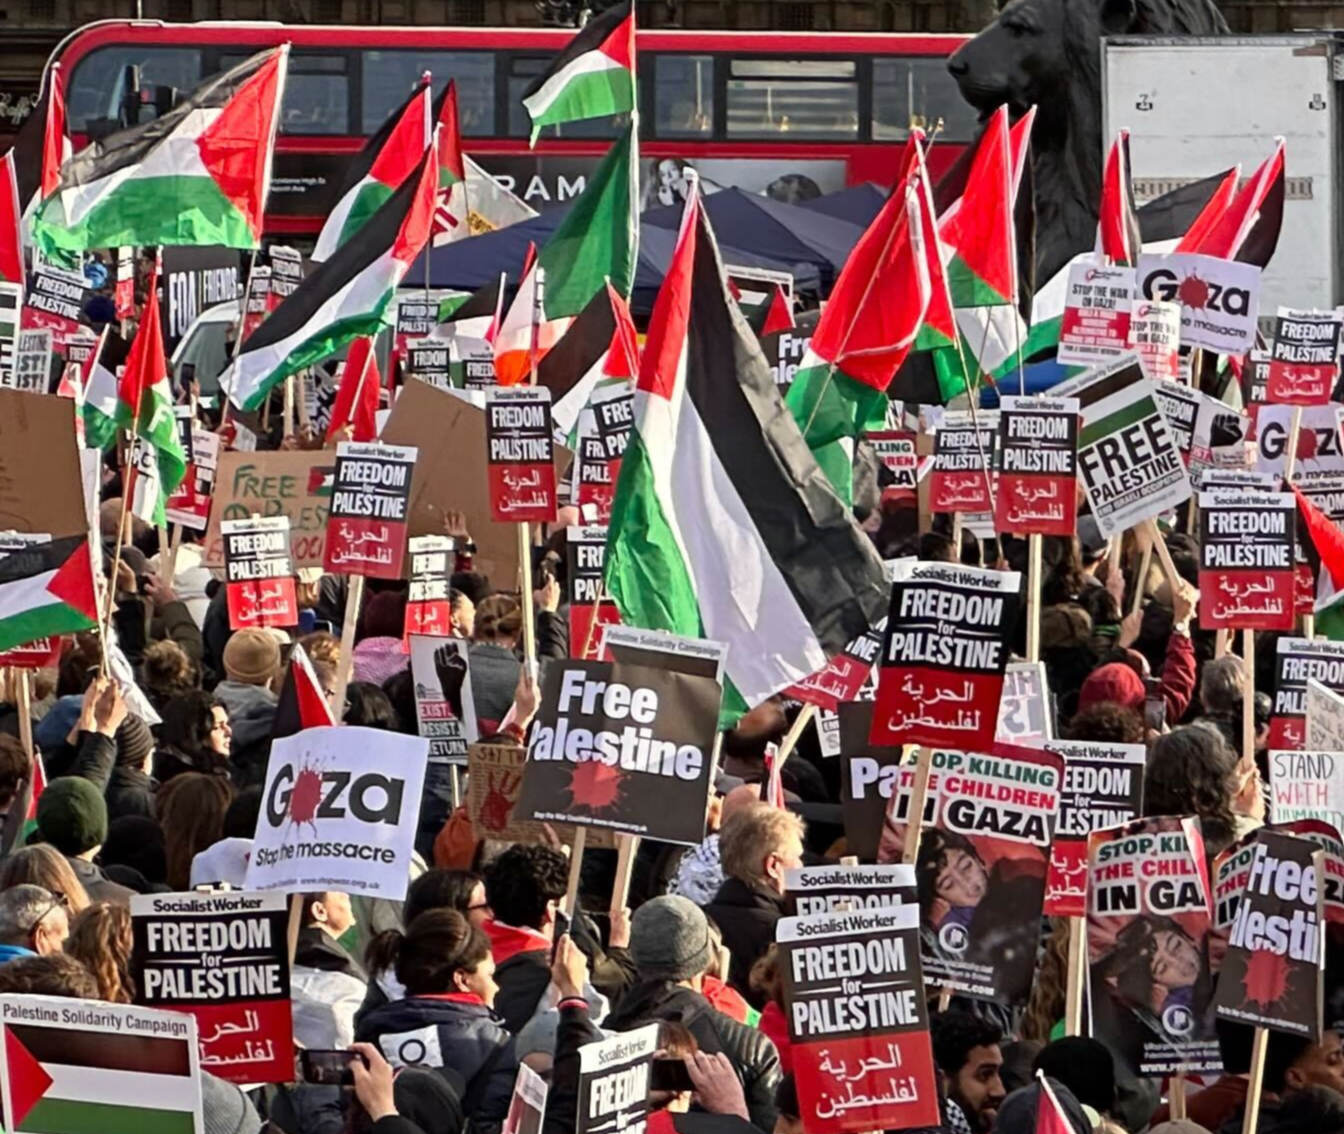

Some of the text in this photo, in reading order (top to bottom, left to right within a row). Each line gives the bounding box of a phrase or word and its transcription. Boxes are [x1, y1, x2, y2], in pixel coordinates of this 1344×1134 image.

[1281, 321, 1334, 341] FREEDOM
[1275, 341, 1335, 363] PALESTINE
[1008, 414, 1068, 440] FREEDOM
[1003, 449, 1072, 473] PALESTINE
[1077, 420, 1173, 488] FREE
[233, 466, 297, 500] FREE
[339, 458, 406, 487] FREEDOM
[1090, 451, 1179, 504] PALESTINE
[331, 490, 404, 519] PALESTINE
[1209, 510, 1285, 536] FREEDOM
[1204, 543, 1288, 568] PALESTINE
[899, 587, 1001, 627] FREEDOM
[888, 636, 1001, 670] PALESTINE
[558, 669, 658, 724] Free
[907, 749, 1056, 788] SOP KILLING
[1274, 753, 1335, 780] STAND
[266, 764, 407, 829] Gza
[900, 771, 1055, 811] TE CHILDREN
[1275, 781, 1329, 807] WITH
[946, 799, 1047, 842] GAZA
[1099, 838, 1154, 862] STOP
[1093, 862, 1135, 882] THE
[1248, 843, 1318, 906] Free
[1096, 884, 1138, 912] IN
[146, 920, 272, 953] FREEDOM
[791, 938, 906, 983] FREEDOM
[143, 965, 281, 1000] PALESTINE
[841, 977, 862, 996] for
[2, 1003, 187, 1036] Palestine Solidarity Campaign
[793, 993, 919, 1037] PALESTINE
